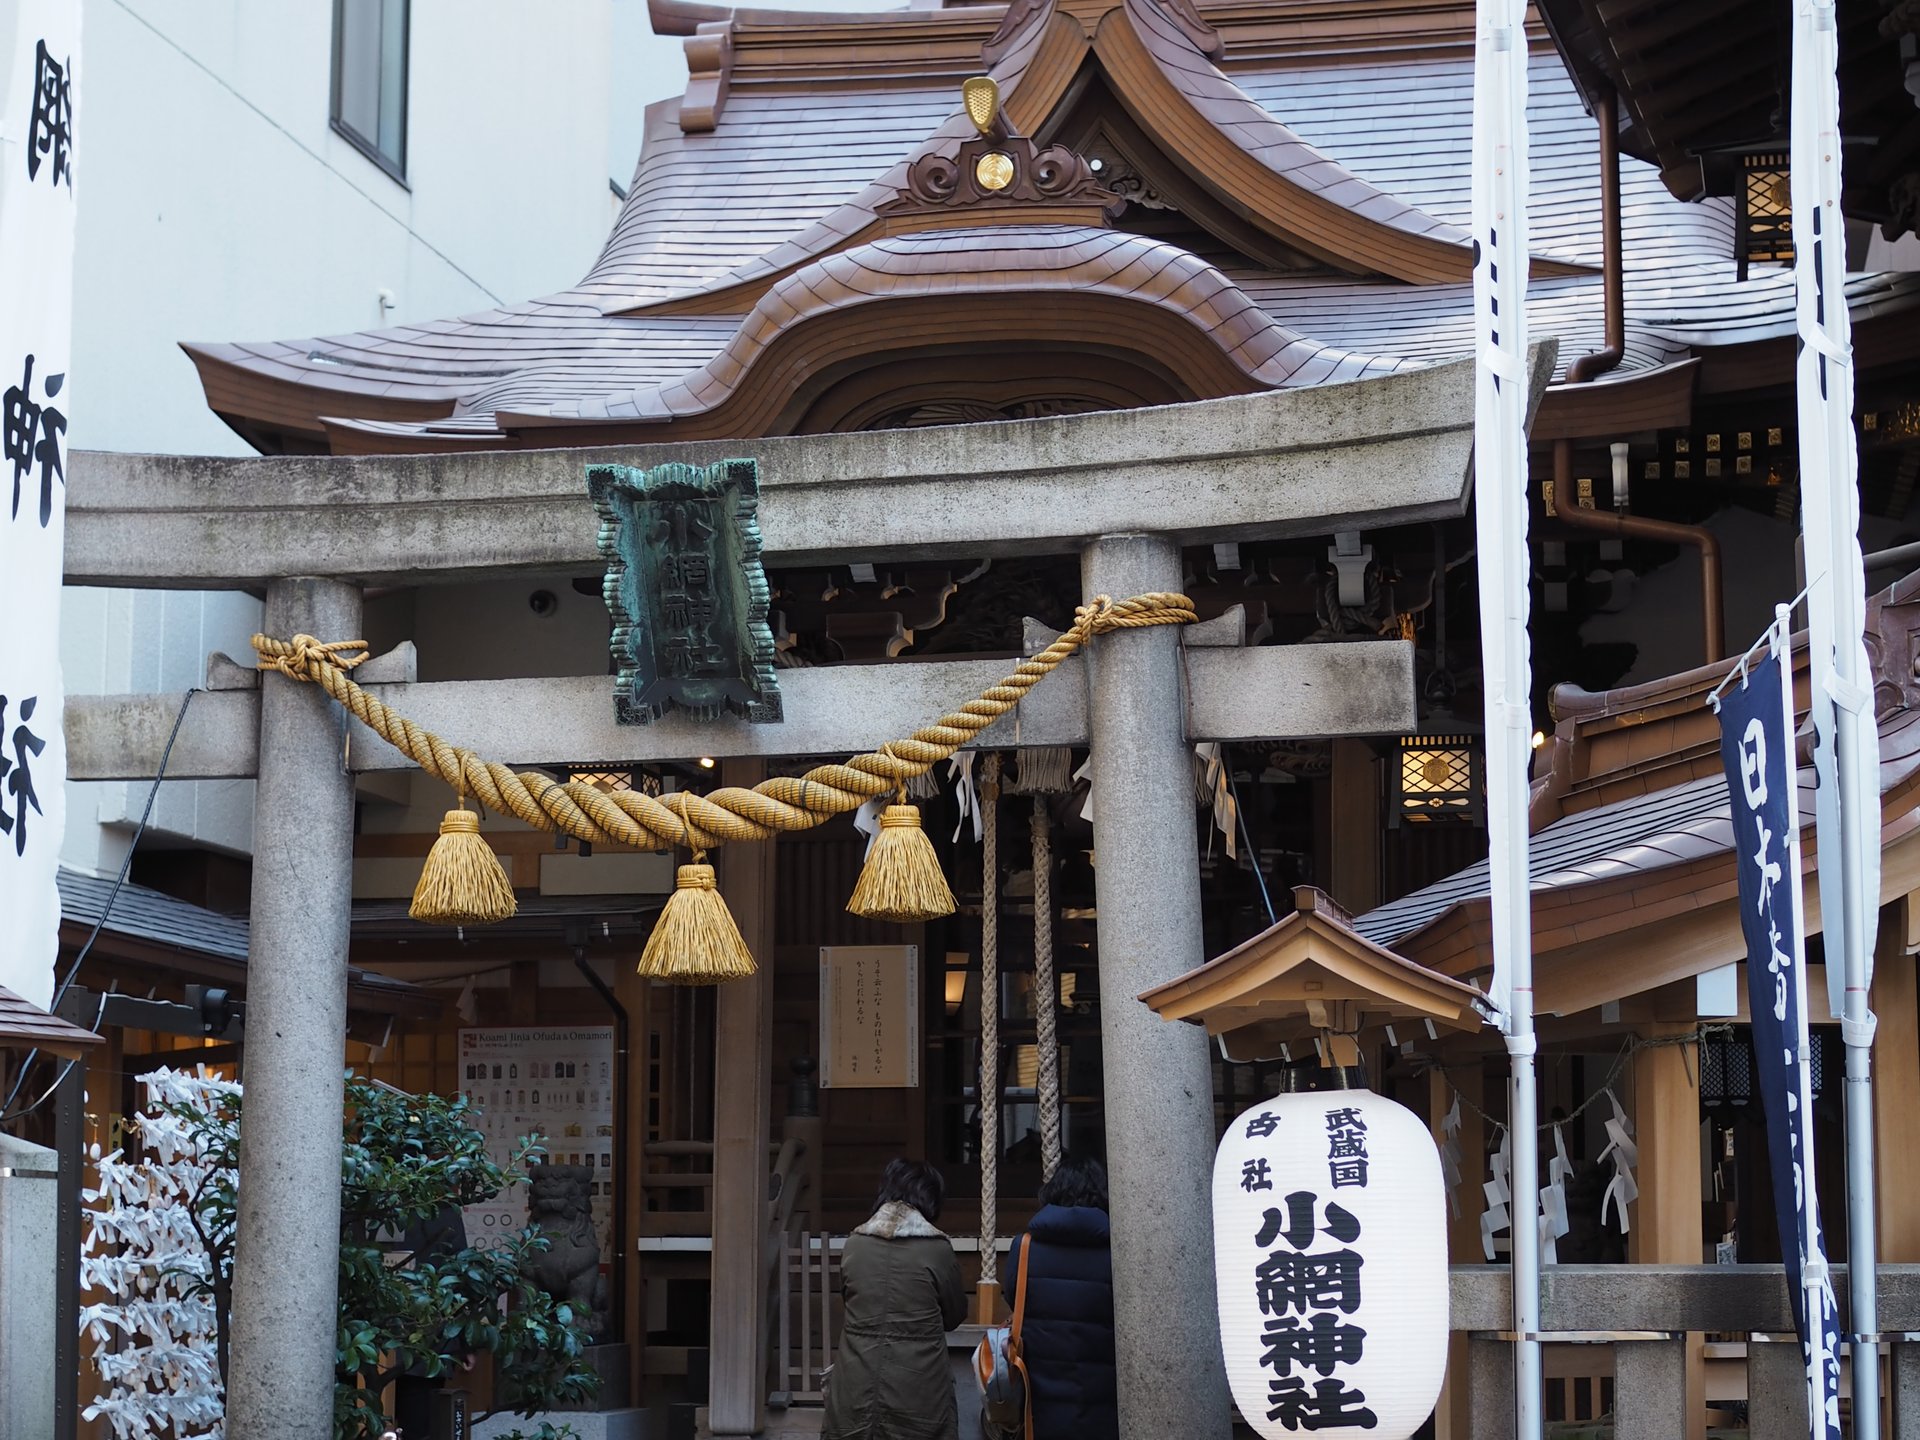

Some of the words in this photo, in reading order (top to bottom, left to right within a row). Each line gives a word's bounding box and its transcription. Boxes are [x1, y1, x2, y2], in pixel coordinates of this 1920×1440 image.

[479, 1032, 508, 1042] Koami
[510, 1032, 531, 1043] Jinja
[532, 1031, 562, 1041] Ofuda
[569, 1031, 612, 1041] Omamori
[1240, 1111, 1282, 1193] 古社
[1325, 1107, 1369, 1190] 武蔵国
[1255, 1191, 1379, 1432] 小網神社
